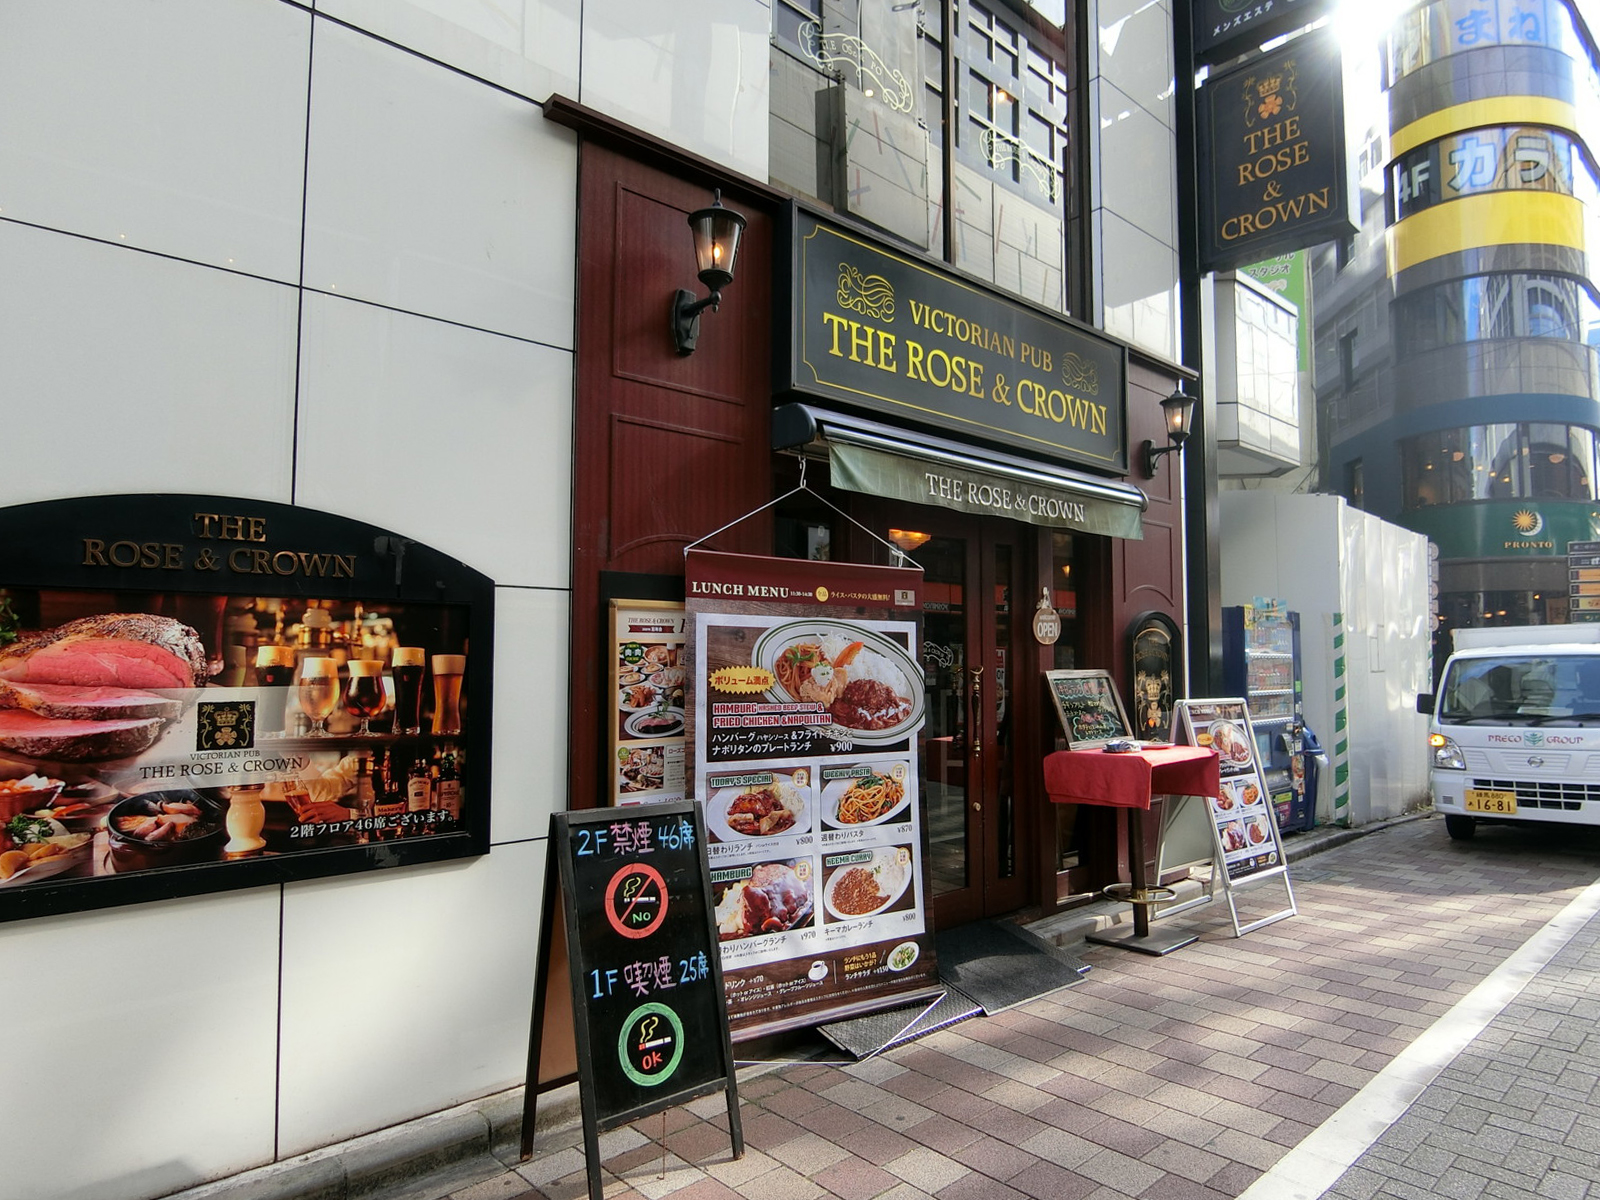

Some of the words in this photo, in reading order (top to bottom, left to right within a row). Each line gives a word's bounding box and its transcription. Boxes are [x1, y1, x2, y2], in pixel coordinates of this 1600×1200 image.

[1213, 0, 1274, 37] メンズエステ
[1243, 115, 1301, 156] THE
[1237, 141, 1310, 186] ROSE
[1263, 180, 1282, 202] &
[1221, 187, 1330, 241] CROWN
[1249, 264, 1291, 278] スタジオ
[908, 299, 1016, 359] VICTORIAN
[1019, 342, 1053, 373] PUB
[823, 312, 897, 374] THE
[905, 340, 985, 399] ROSE
[991, 373, 1012, 407] &
[1016, 378, 1107, 437] CROWN
[925, 472, 963, 503] THE
[968, 485, 1011, 510] ROSE
[1014, 493, 1028, 511] &
[1028, 492, 1085, 524] CROWN
[195, 512, 267, 543] THE
[1504, 541, 1553, 549] PRONTO
[82, 539, 184, 571] ROSE
[195, 549, 221, 572] &
[228, 549, 357, 579] CROWN
[692, 581, 744, 596] LUNCH
[747, 585, 789, 599] MENU
[1037, 622, 1058, 638] OPEN
[714, 675, 769, 687] ボリューム満点
[713, 703, 757, 715] HAMBURG
[817, 702, 824, 713] &
[713, 716, 741, 728] FRIED
[742, 715, 780, 728] CHICKEN
[712, 731, 756, 743] ハンバーグ
[1546, 736, 1584, 744] GROUP
[829, 740, 853, 753] ¥900
[190, 750, 241, 761] VICTORIAN
[243, 750, 261, 758] PUB
[139, 764, 176, 780] THE
[179, 762, 224, 777] ROSE
[227, 761, 239, 773] &
[242, 757, 304, 772] CROWN
[849, 766, 872, 778] PASTA
[711, 777, 743, 788] TODAY'S
[743, 774, 773, 785] SPECIAL
[1476, 799, 1511, 812] 16-81
[290, 809, 454, 839] 2階フロア46席ございます。
[577, 829, 607, 856] 2F
[609, 821, 656, 856] 禁煙
[657, 823, 696, 851] 46席
[795, 835, 814, 846] ¥800
[820, 830, 864, 844] 週替わりパスタ
[897, 824, 913, 835] ¥870
[710, 868, 753, 883] HAMBURG
[632, 911, 652, 924] NO
[824, 920, 873, 936] キーマカレーランチ
[902, 911, 916, 922] ¥800
[800, 930, 816, 941] ¥970
[591, 968, 619, 999] 1F
[623, 956, 673, 998] 喫煙
[679, 950, 709, 982] 25席
